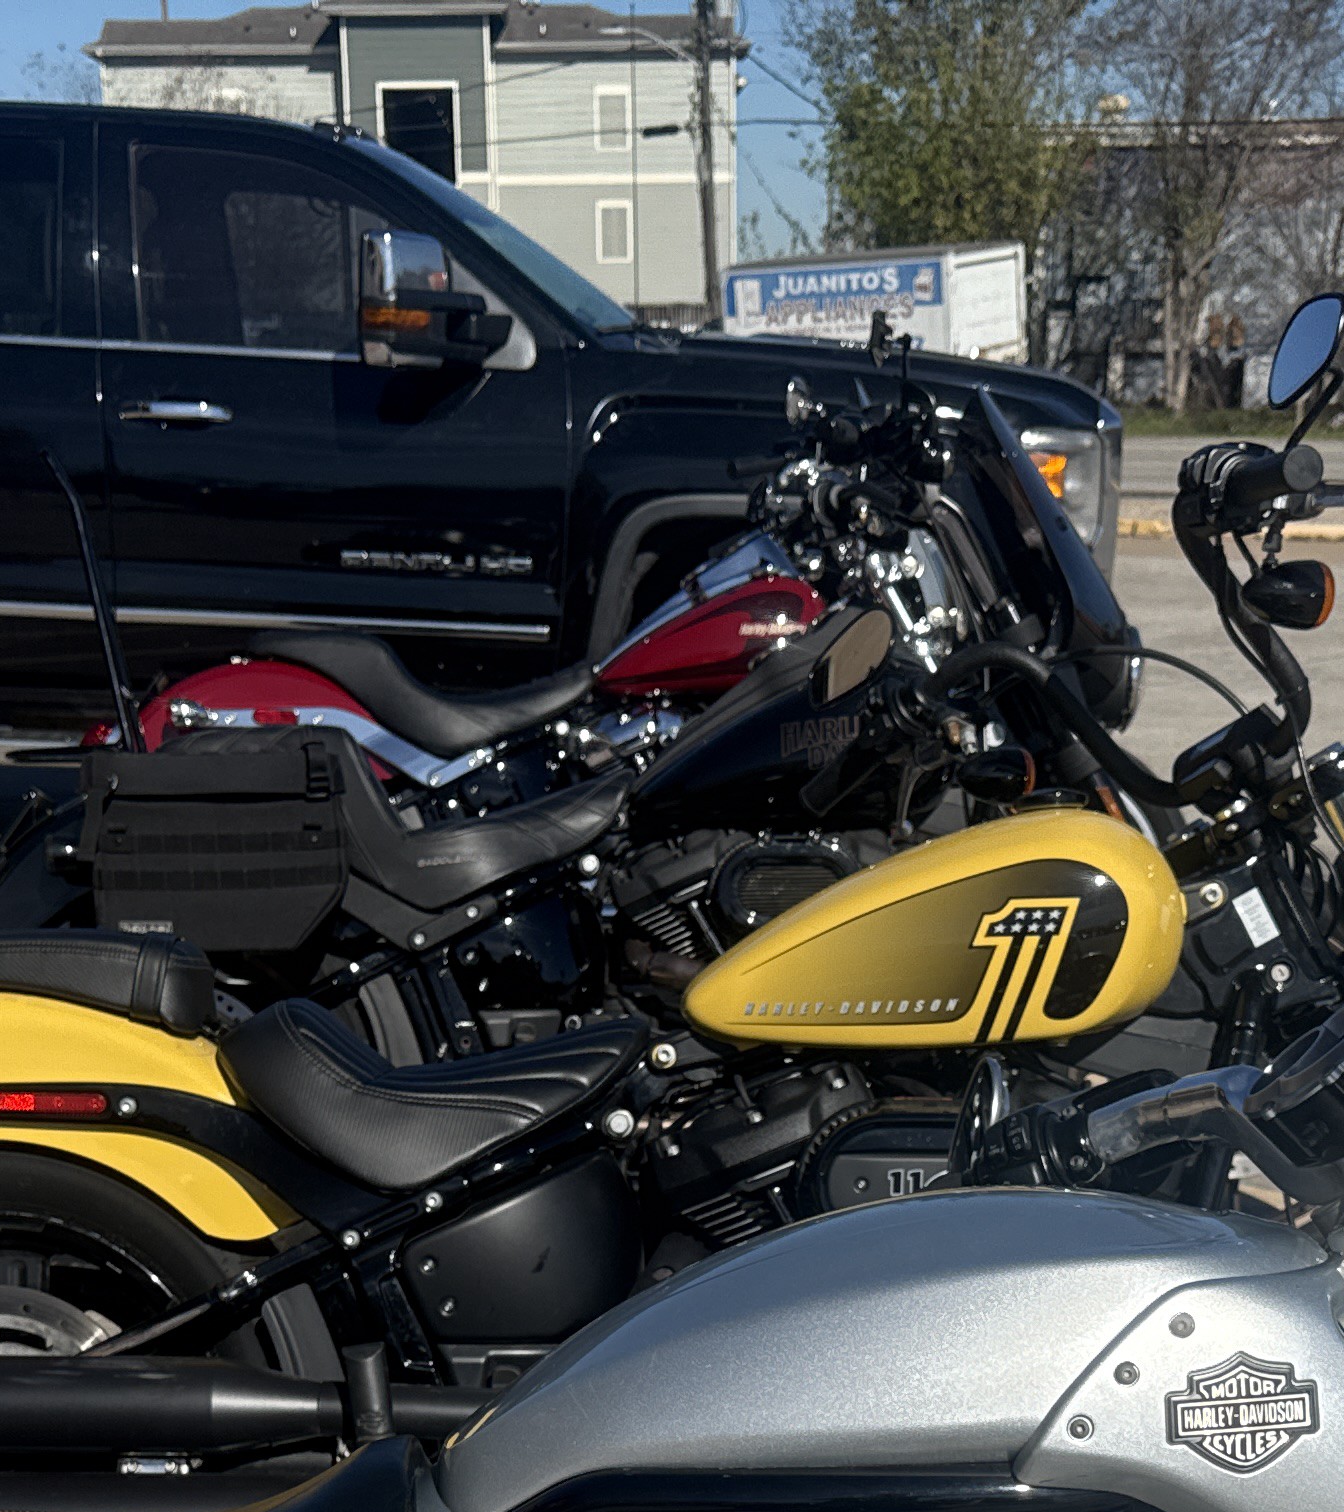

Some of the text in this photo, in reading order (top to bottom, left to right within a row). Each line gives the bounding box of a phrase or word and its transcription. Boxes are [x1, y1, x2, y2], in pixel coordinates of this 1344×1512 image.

[772, 266, 900, 299] JUANITO'S
[744, 998, 959, 1016] HARLEY-DAVIDSON
[887, 1168, 950, 1197] 11
[1211, 1373, 1276, 1399] MOTOR
[1184, 1400, 1305, 1430] HARLEY-DAVIDSON
[1212, 1430, 1279, 1461] CYCLES
